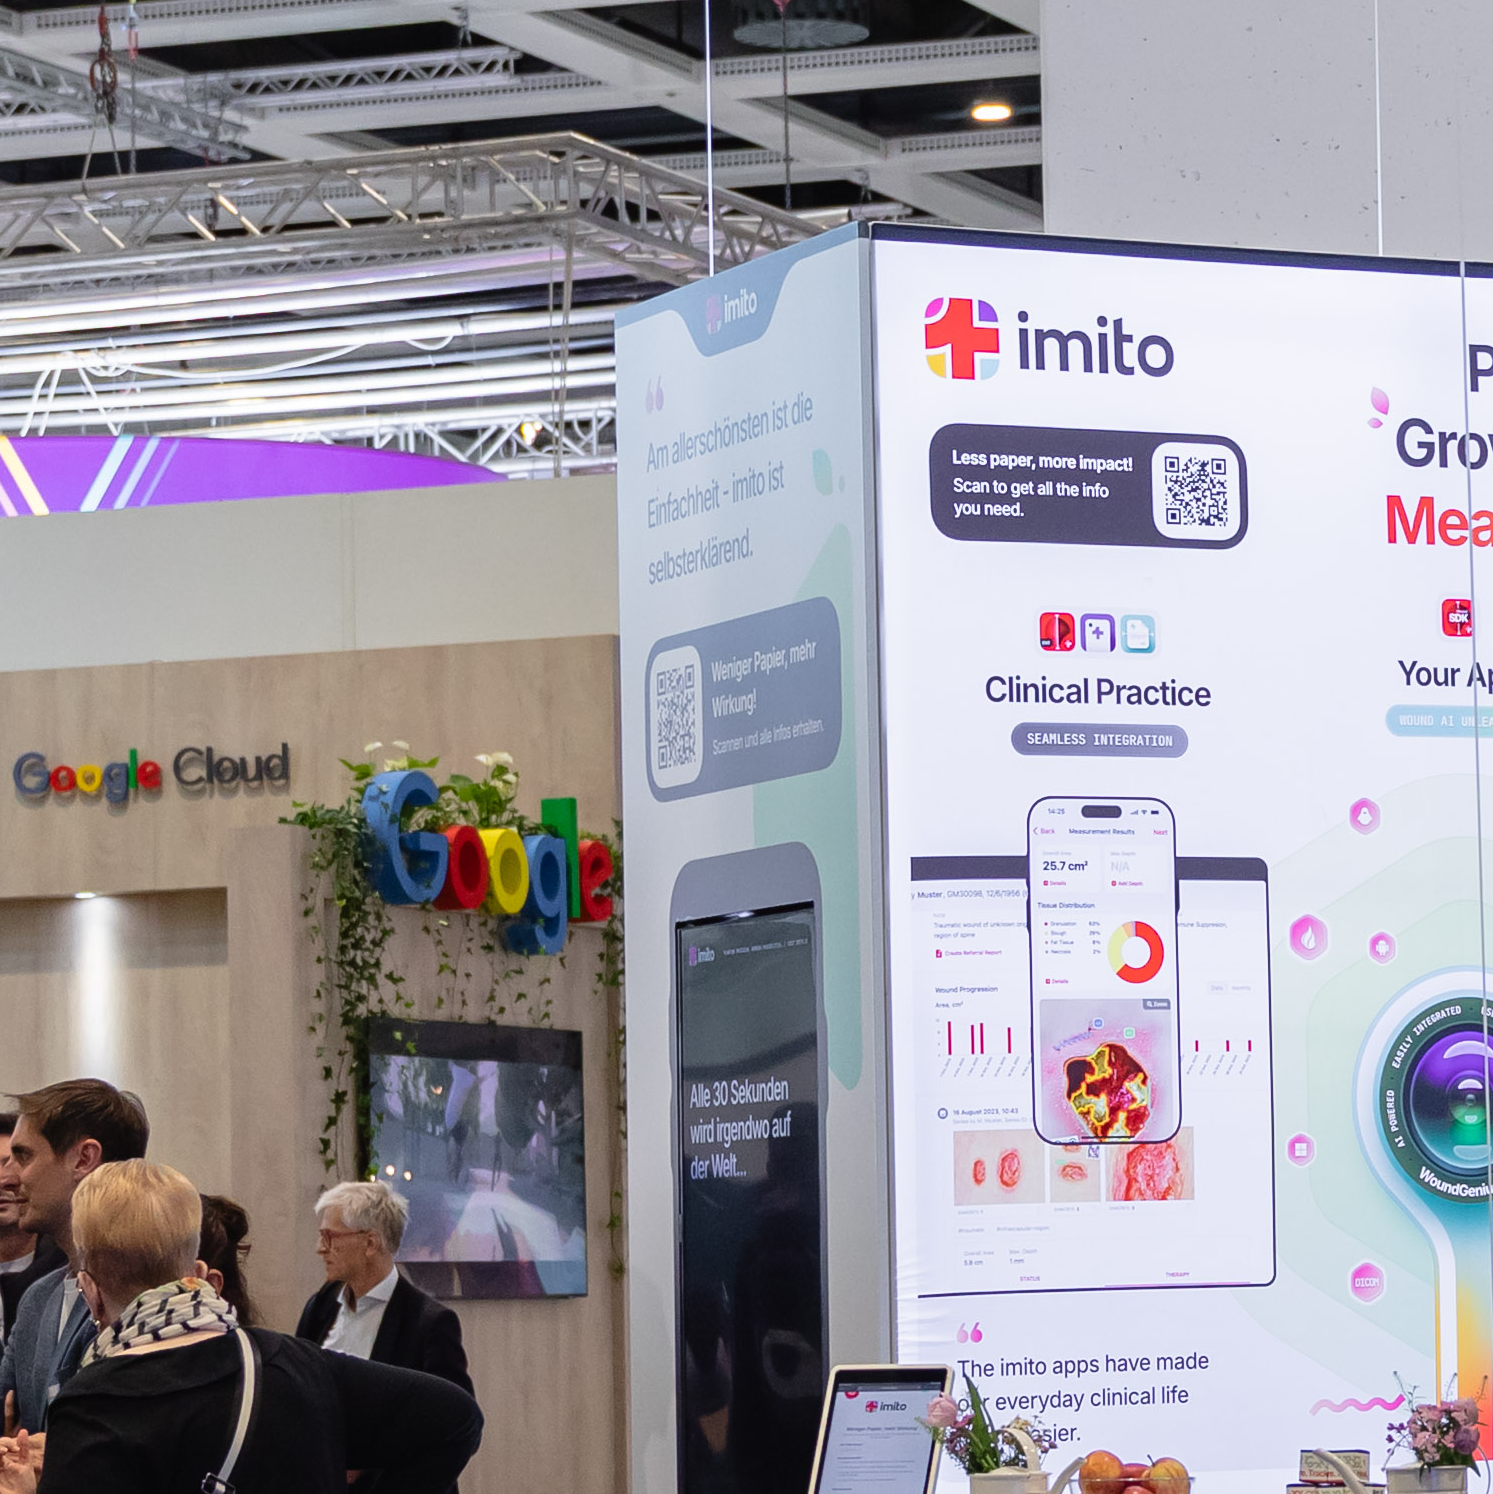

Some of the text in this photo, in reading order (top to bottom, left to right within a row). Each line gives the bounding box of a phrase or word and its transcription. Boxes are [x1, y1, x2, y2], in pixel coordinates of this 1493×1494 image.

[724, 291, 757, 323] imito
[1017, 310, 1175, 378] imito
[647, 392, 813, 473] Am allerschönsten ist die
[952, 448, 1133, 475] Less paper, more impact!
[648, 461, 784, 529] Einfachheit imito ist
[953, 478, 1109, 501] Scan to get all the info
[954, 501, 1024, 521] you need.
[649, 527, 753, 585] selbsterklärend.
[1449, 613, 1468, 623] SDK
[712, 639, 816, 682] Weniger Papier, mehr
[1398, 660, 1460, 686] Your
[712, 688, 756, 717] Wirkung!
[985, 675, 1211, 708] Clinical Practice
[1399, 715, 1454, 726] WOUND AI
[713, 719, 824, 755] Scannen und alle Infos erhalten.
[1027, 732, 1173, 748] SEAMLESS INTEGRATION
[14, 742, 290, 804] Google Cloud
[362, 770, 613, 955] Google
[1043, 861, 1088, 871] 25.7 cm²
[1111, 862, 1130, 871] N/A
[1392, 1006, 1461, 1068] EASILY INTEGRATED
[690, 1076, 788, 1108] Alle 30 Sekunden
[690, 1110, 791, 1148] wird irgendwo auf
[1386, 1089, 1405, 1149] AI POWERED
[691, 1153, 746, 1179] der Welt...
[958, 1353, 1209, 1382] The imito apps have made
[880, 1402, 906, 1411] imito
[995, 1386, 1189, 1415] everyday clinical life
